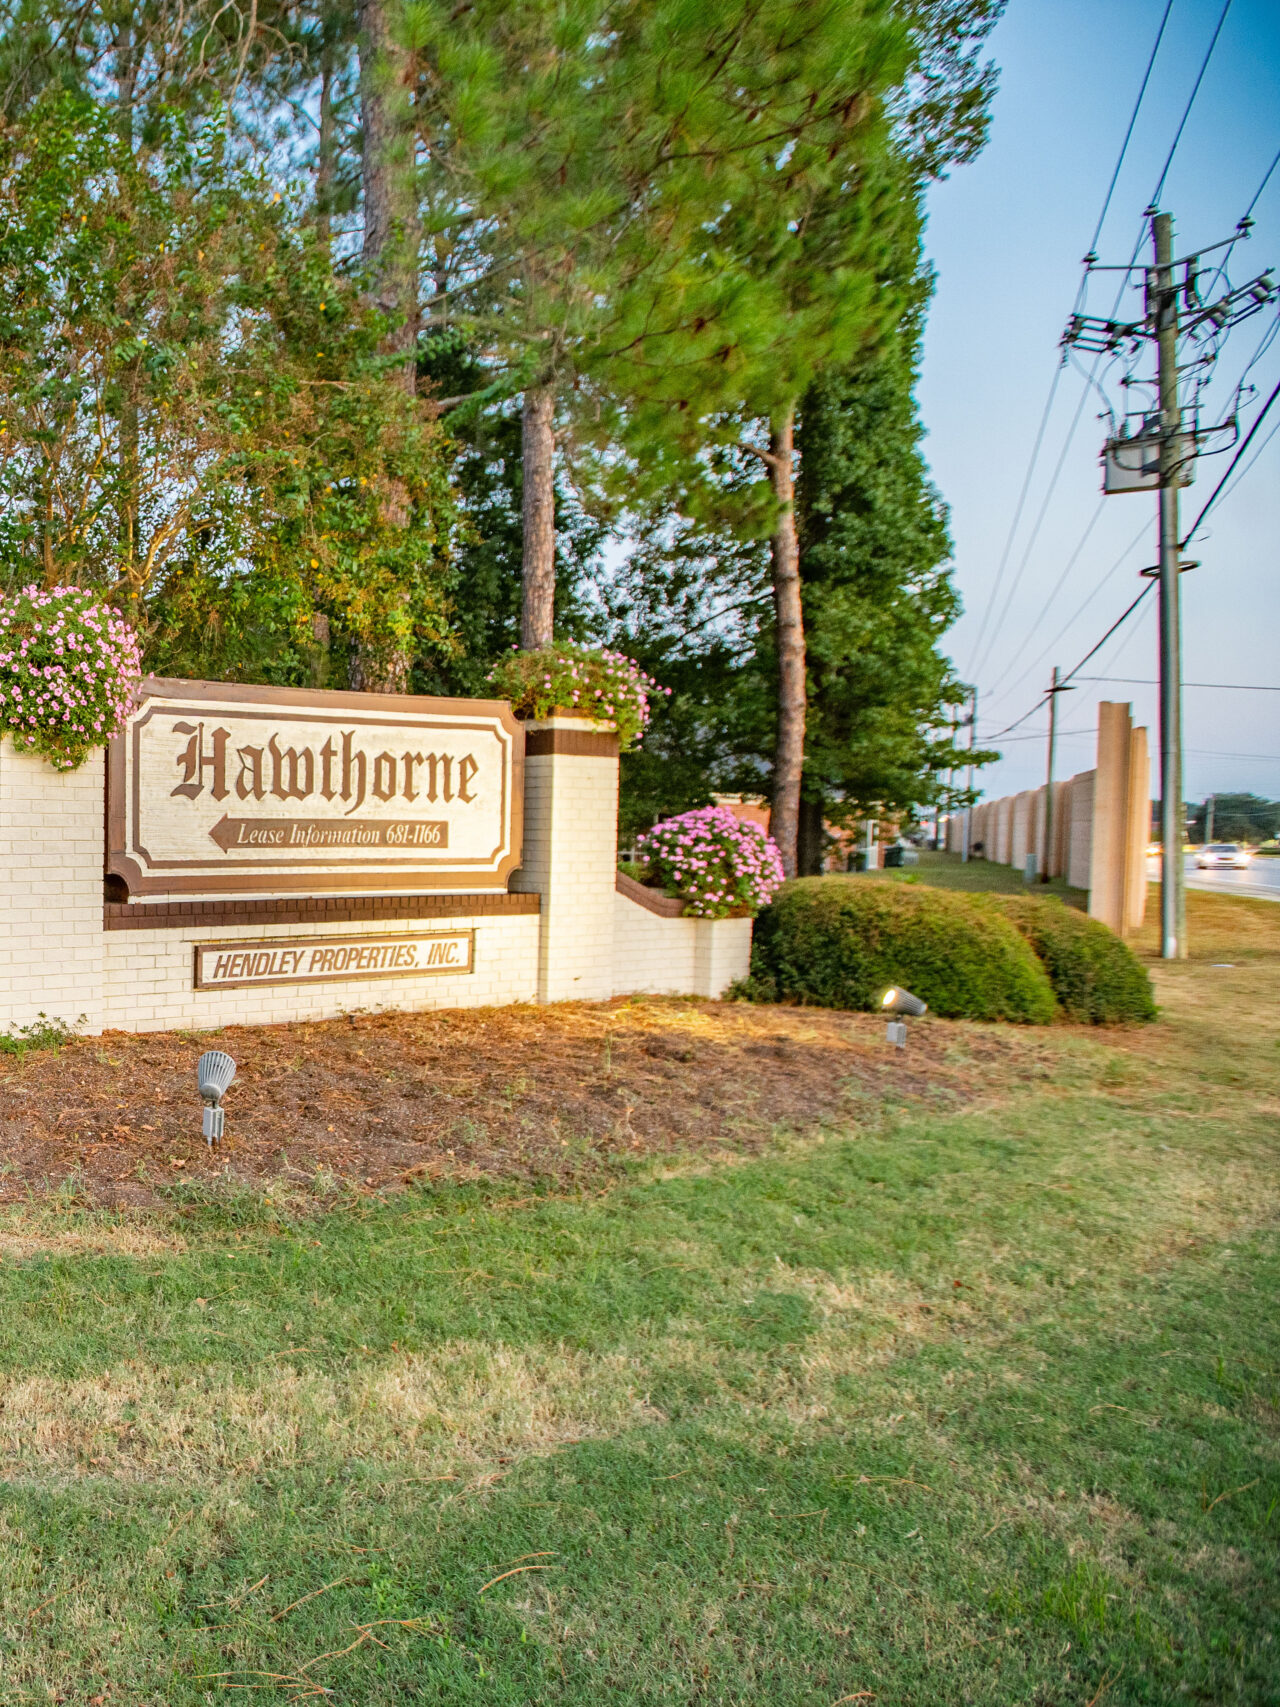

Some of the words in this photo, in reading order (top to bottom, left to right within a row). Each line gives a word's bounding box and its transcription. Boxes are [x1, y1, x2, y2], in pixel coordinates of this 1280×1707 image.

[170, 721, 479, 816] Hawthorne
[237, 823, 285, 844] Lease
[290, 823, 380, 847] Information
[386, 824, 441, 844] 681-1166
[213, 950, 306, 978] HENDLEY
[309, 945, 419, 972] PROPERTIES,
[427, 942, 460, 965] INC.
